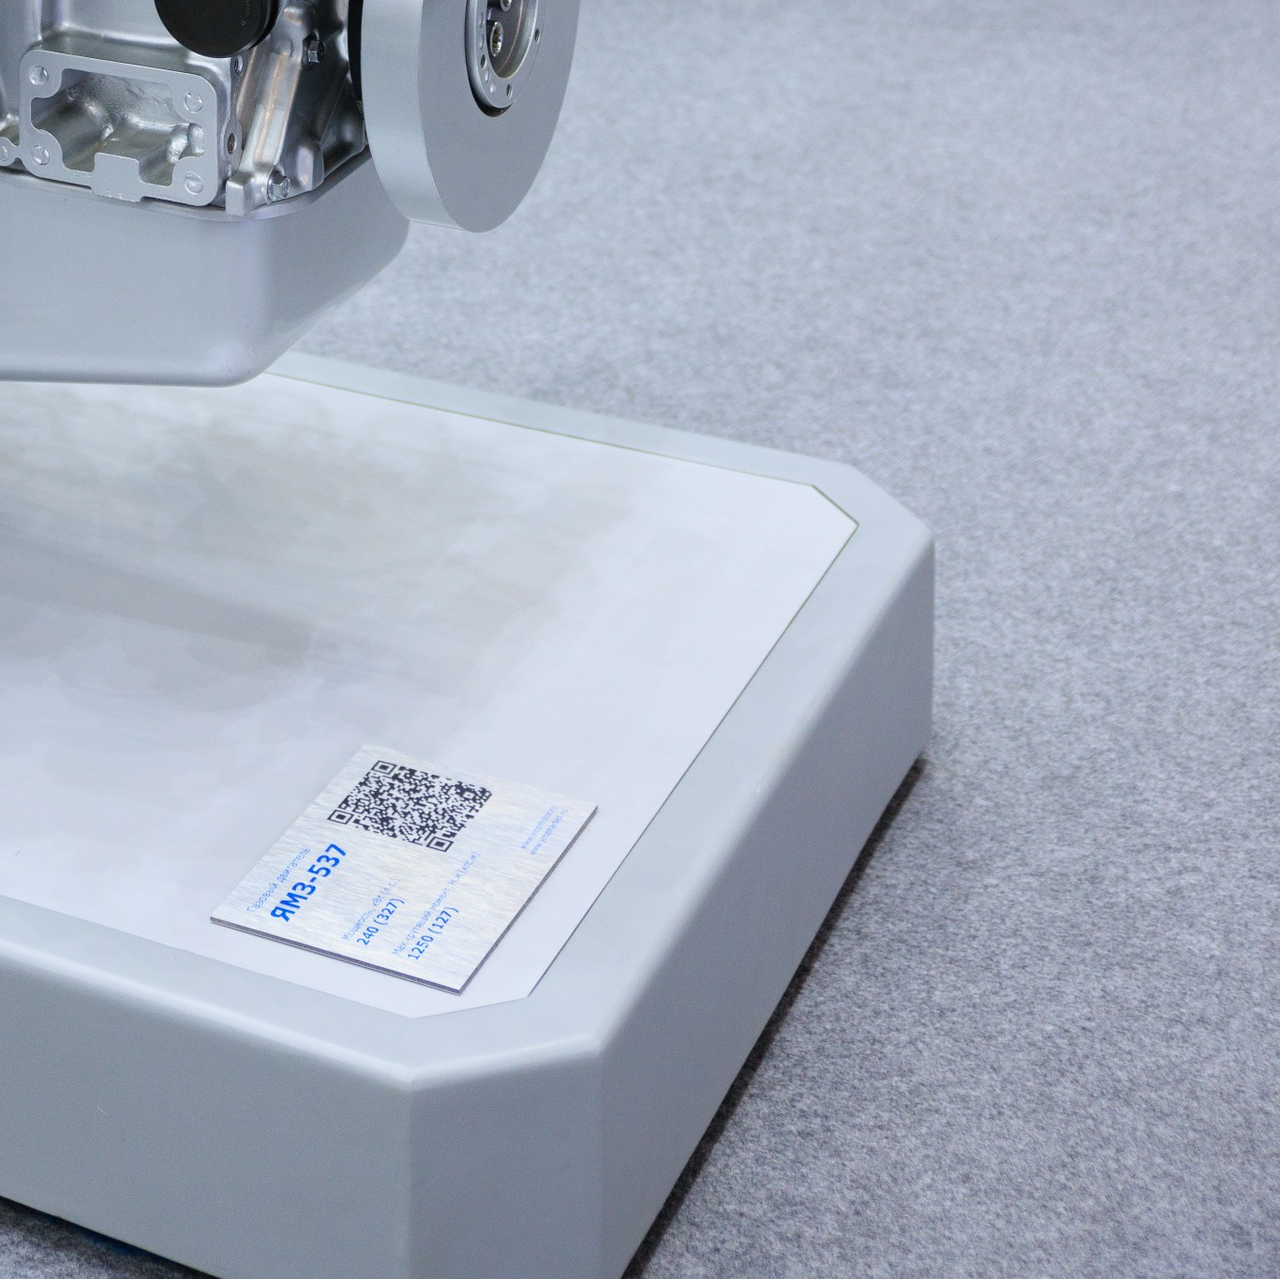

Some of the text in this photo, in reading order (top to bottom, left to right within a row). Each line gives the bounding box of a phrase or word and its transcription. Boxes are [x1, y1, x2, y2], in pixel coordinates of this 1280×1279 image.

[246, 847, 311, 912] Газовый двигатель
[270, 844, 346, 922] ЯМЗ-537
[357, 898, 404, 945] 240 (327)
[407, 907, 459, 960] 1250 (127)
